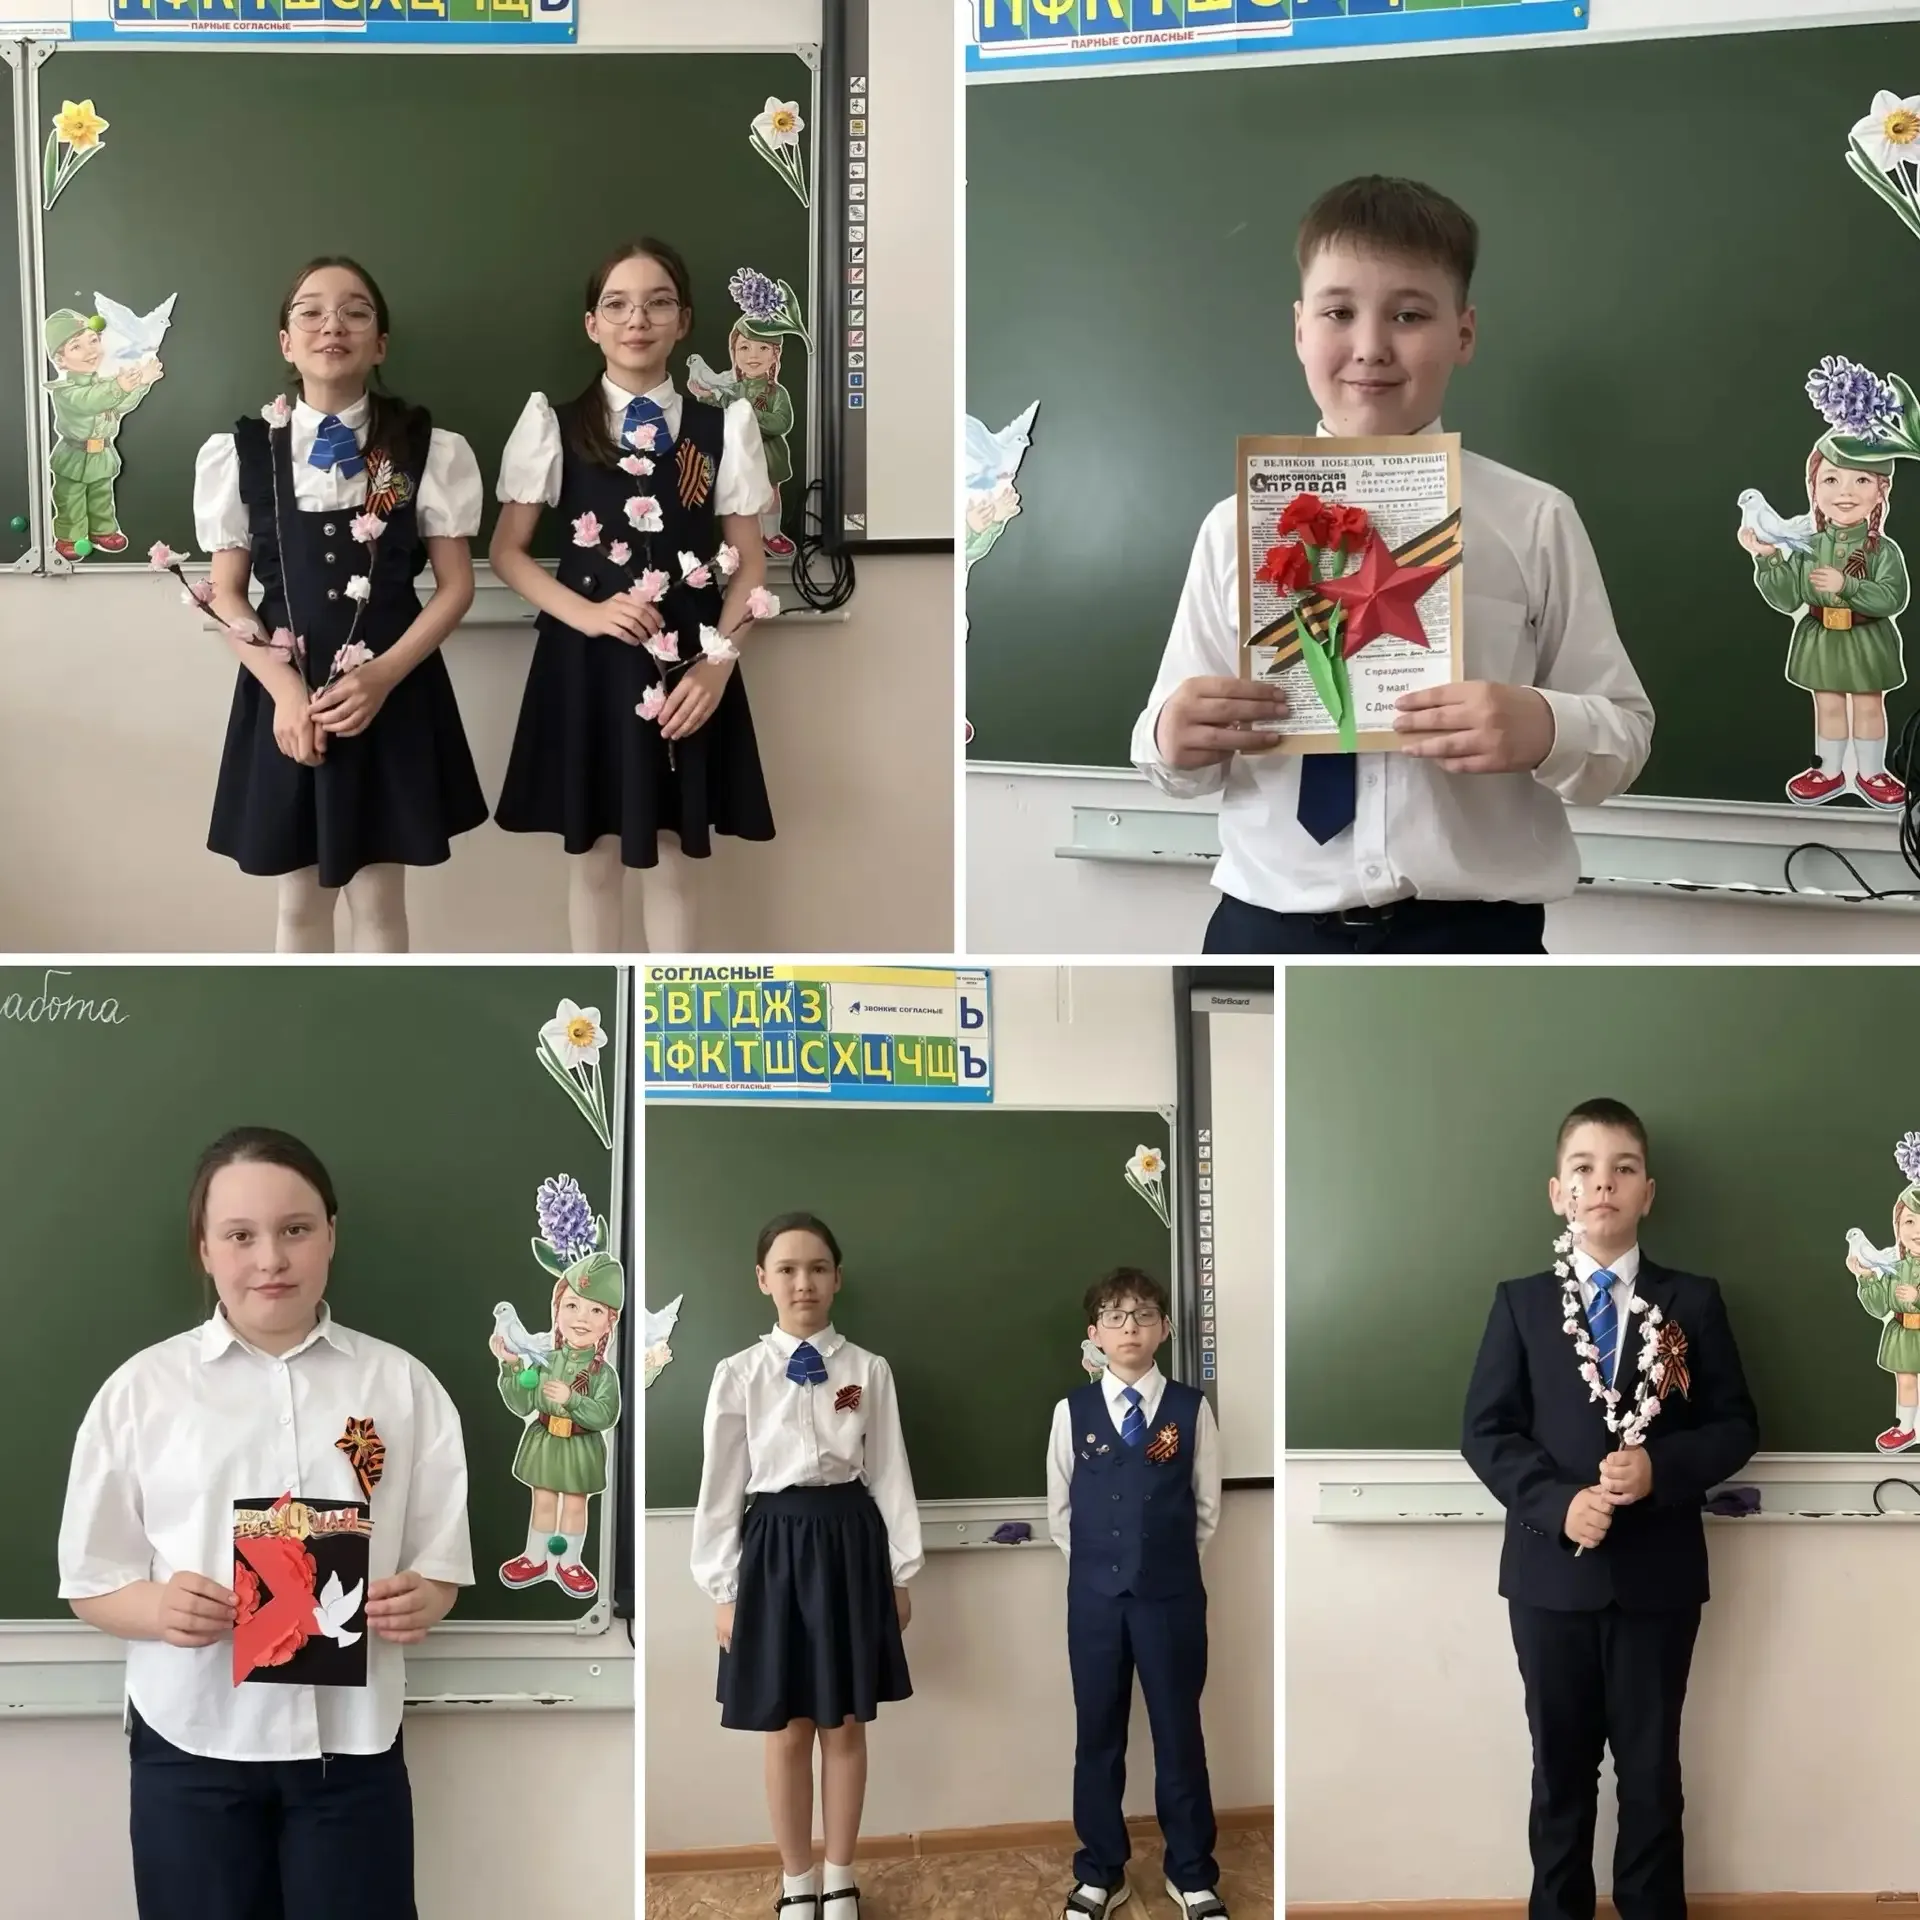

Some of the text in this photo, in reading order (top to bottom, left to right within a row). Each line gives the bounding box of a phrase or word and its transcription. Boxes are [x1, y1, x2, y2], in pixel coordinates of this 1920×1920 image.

[191, 22, 291, 30] ПАРНЫЕ СОГЛАСНЫЕ
[1071, 31, 1195, 49] ПАРНЫЕ СОГЛАСНЫЕ
[1266, 472, 1346, 482] КОМСОМОЛЬСКАЯ
[1267, 481, 1346, 493] ПРАВДА
[1365, 667, 1425, 676] С праздником
[1378, 683, 1410, 693] 9 мая!
[1365, 702, 1395, 712] С Дне
[651, 966, 774, 981] СОГЛАСНЫЕ
[0, 969, 130, 1025] абота
[1211, 996, 1250, 1006] StarBoard
[864, 1005, 943, 1015] ЗВОНКИЕ СОГЛАСНЫЕ
[960, 996, 984, 1029] Ь
[959, 1045, 987, 1079] Ъ
[289, 1502, 308, 1535] 9
